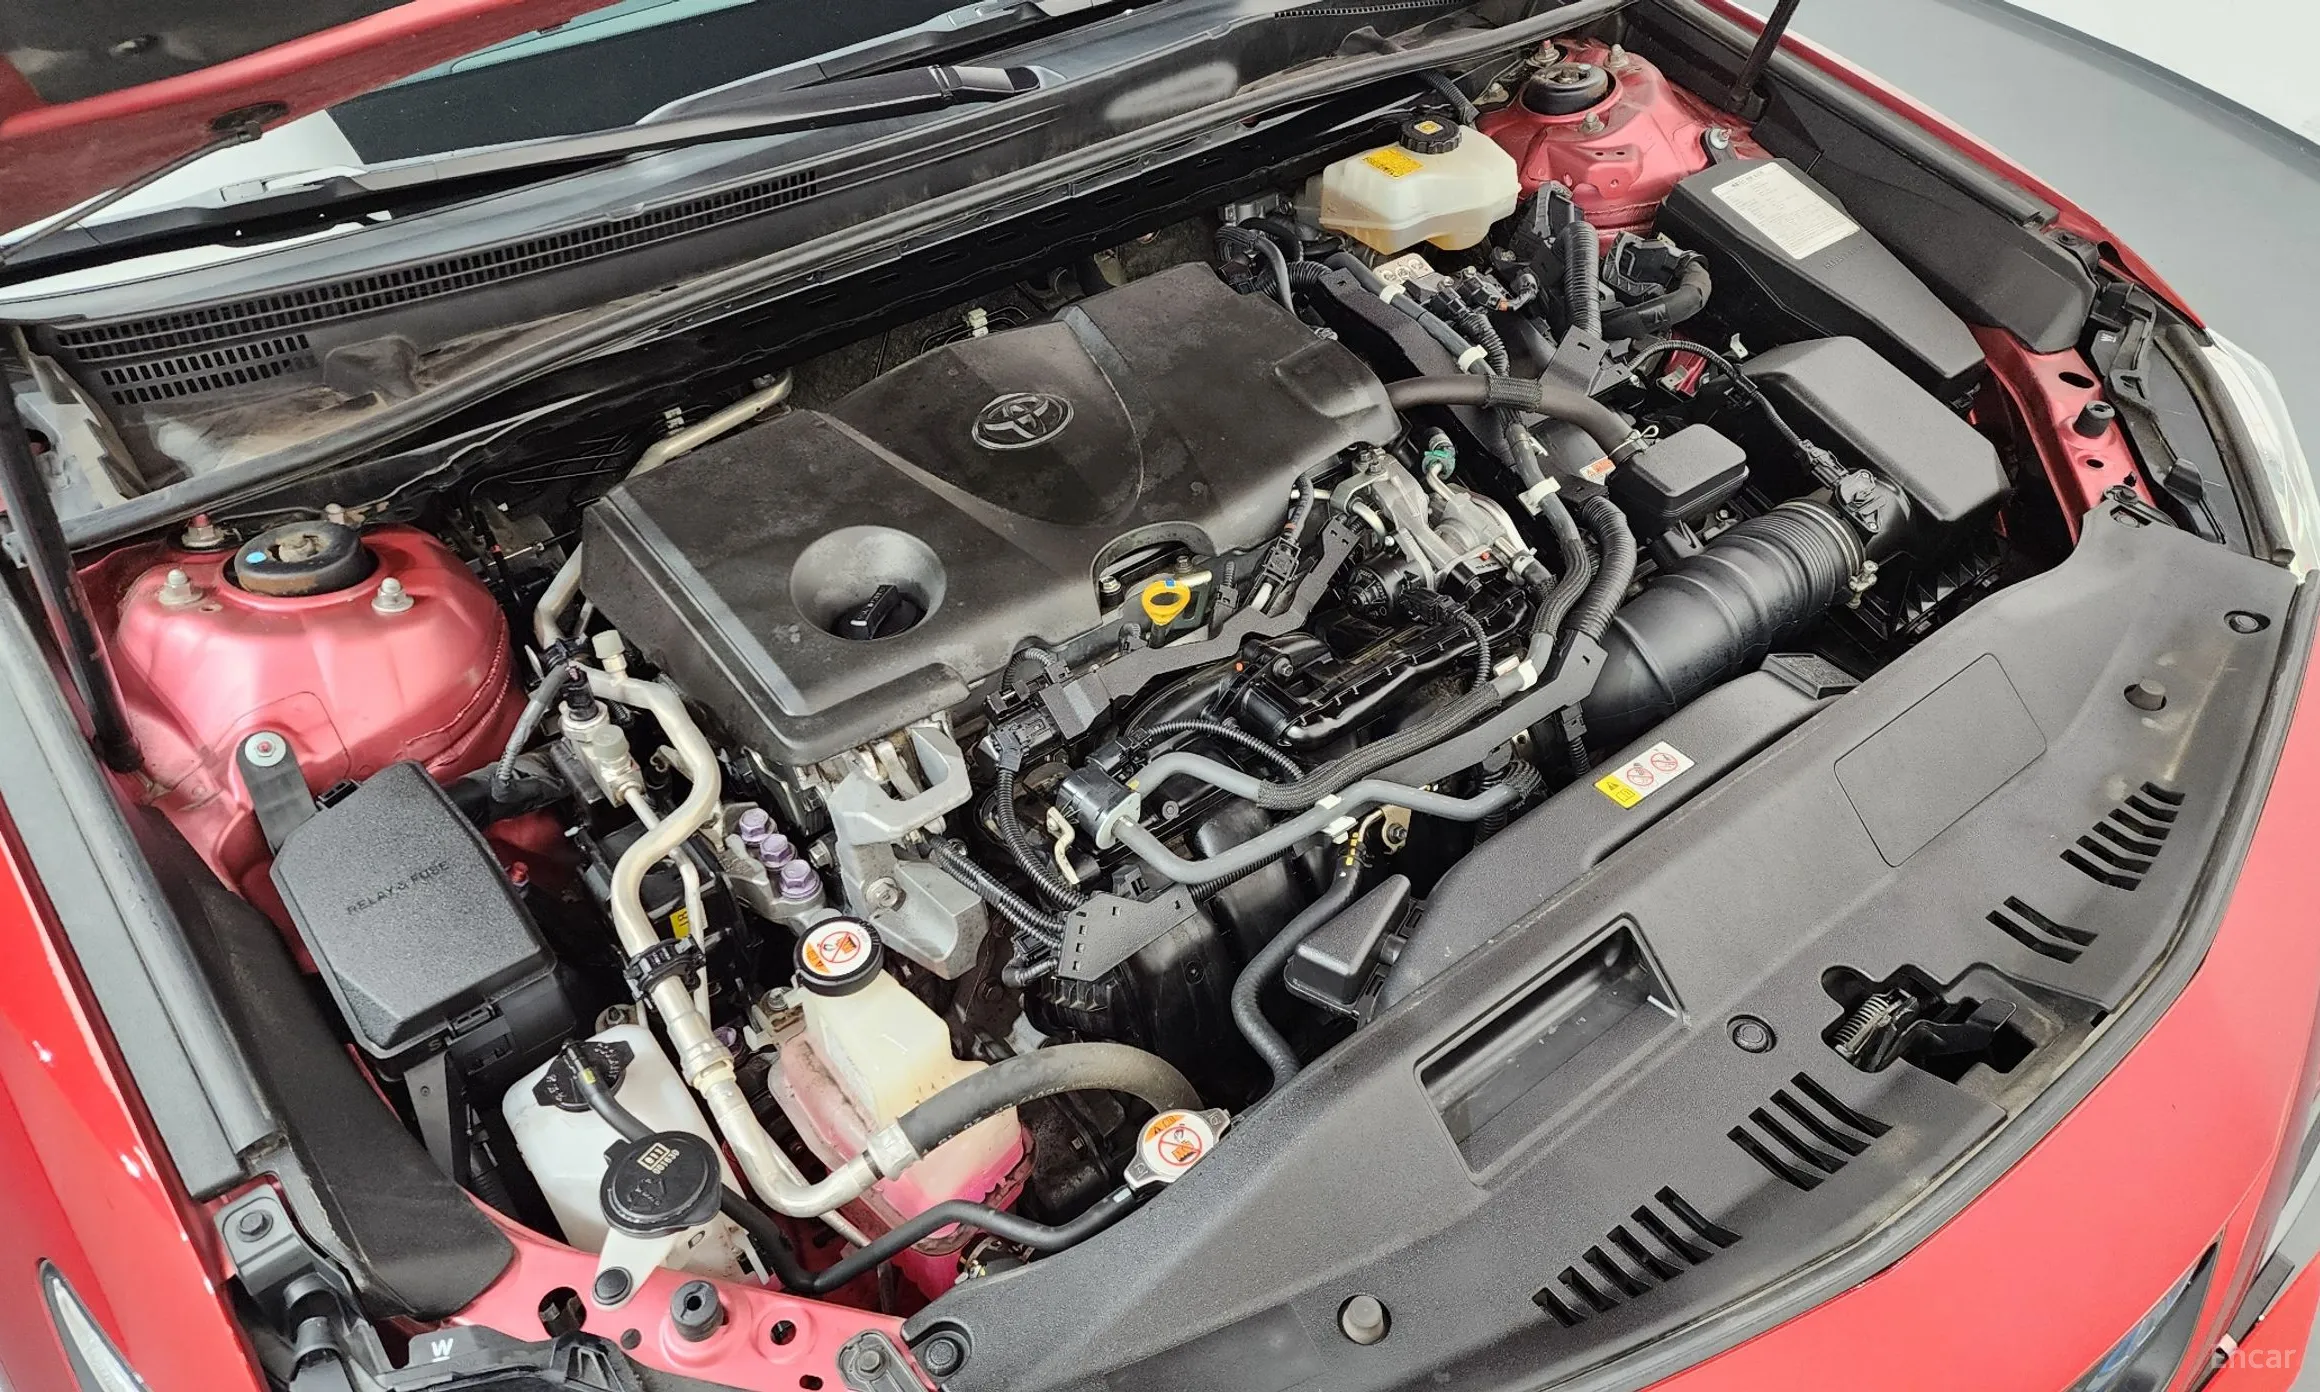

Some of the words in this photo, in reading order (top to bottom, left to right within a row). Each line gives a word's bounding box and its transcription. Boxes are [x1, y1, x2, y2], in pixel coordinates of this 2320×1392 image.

[346, 885, 395, 916] RELAY
[410, 860, 450, 884] FUSE
[431, 1338, 454, 1358] W
